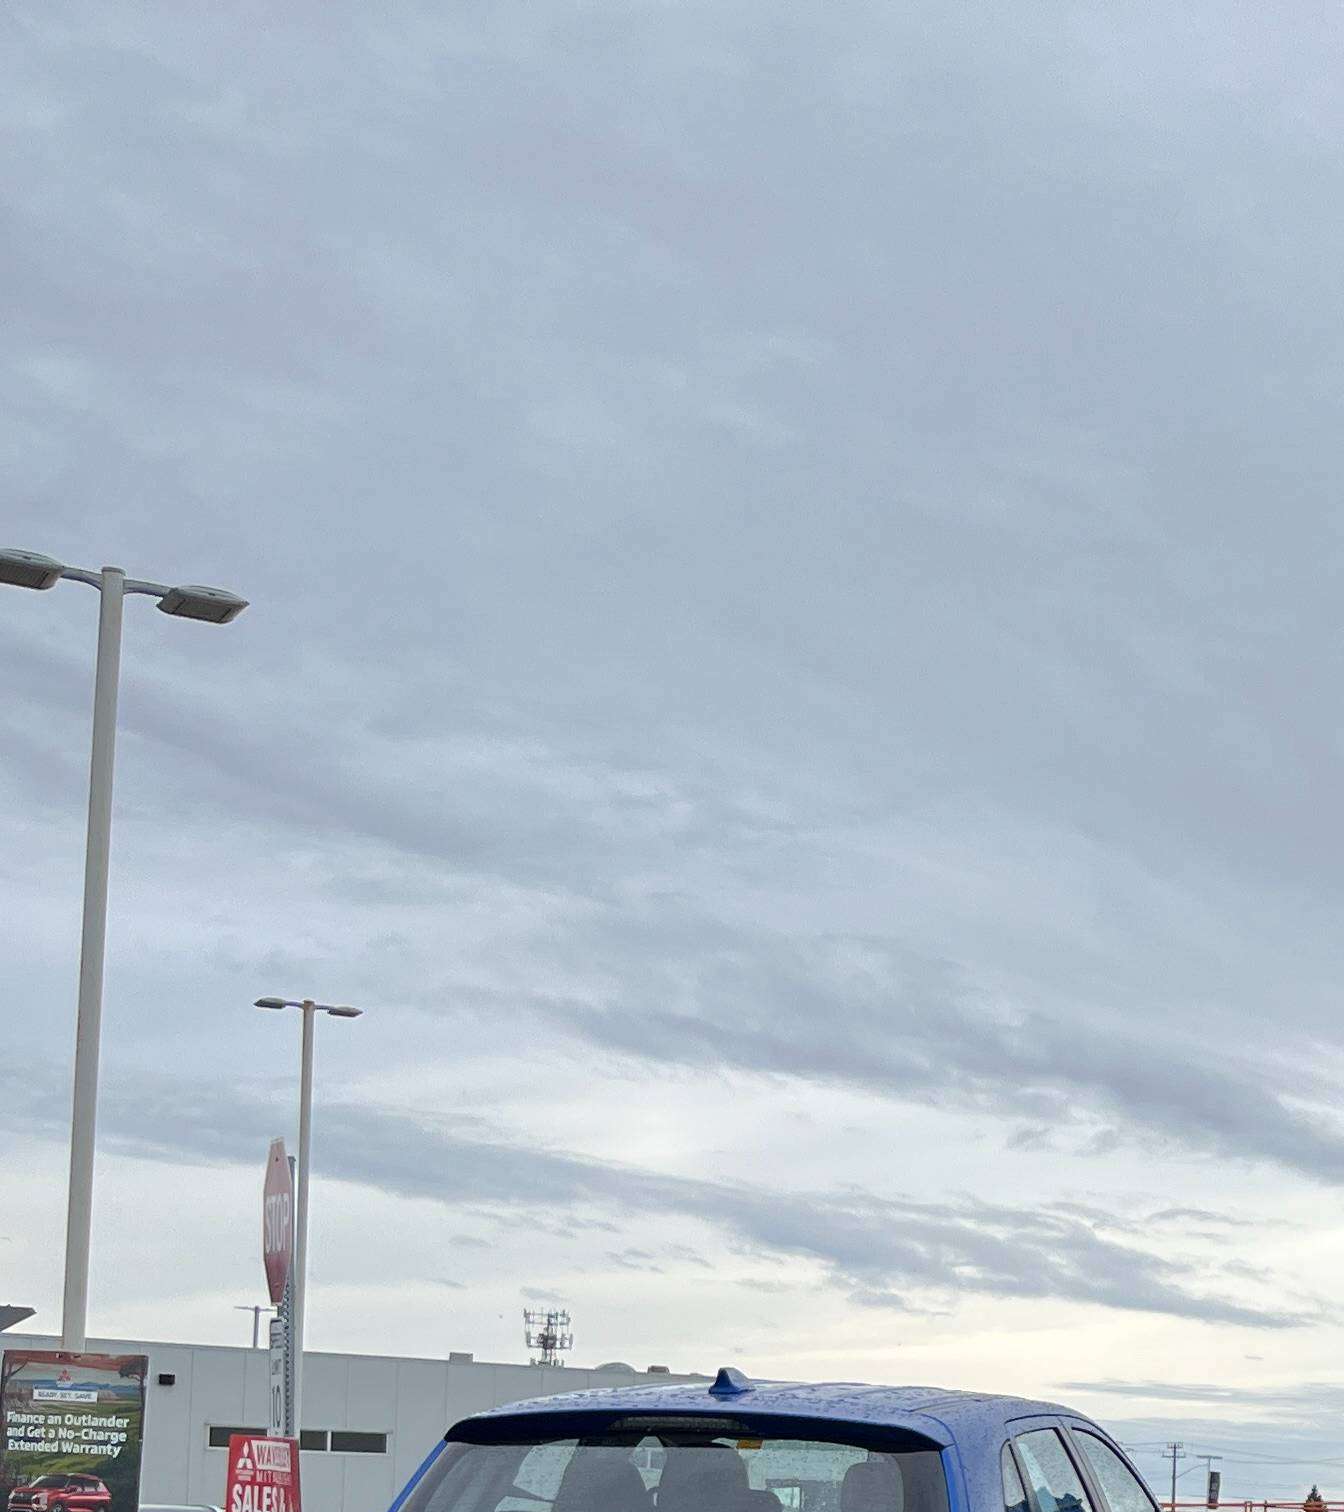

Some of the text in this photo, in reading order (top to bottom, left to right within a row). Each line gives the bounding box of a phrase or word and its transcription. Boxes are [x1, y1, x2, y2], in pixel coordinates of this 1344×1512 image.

[265, 1193, 289, 1253] STOP
[7, 1411, 130, 1429] Finance an Outlander
[7, 1425, 128, 1443] and Get a No-Charge
[8, 1439, 122, 1458] Extended Warranty
